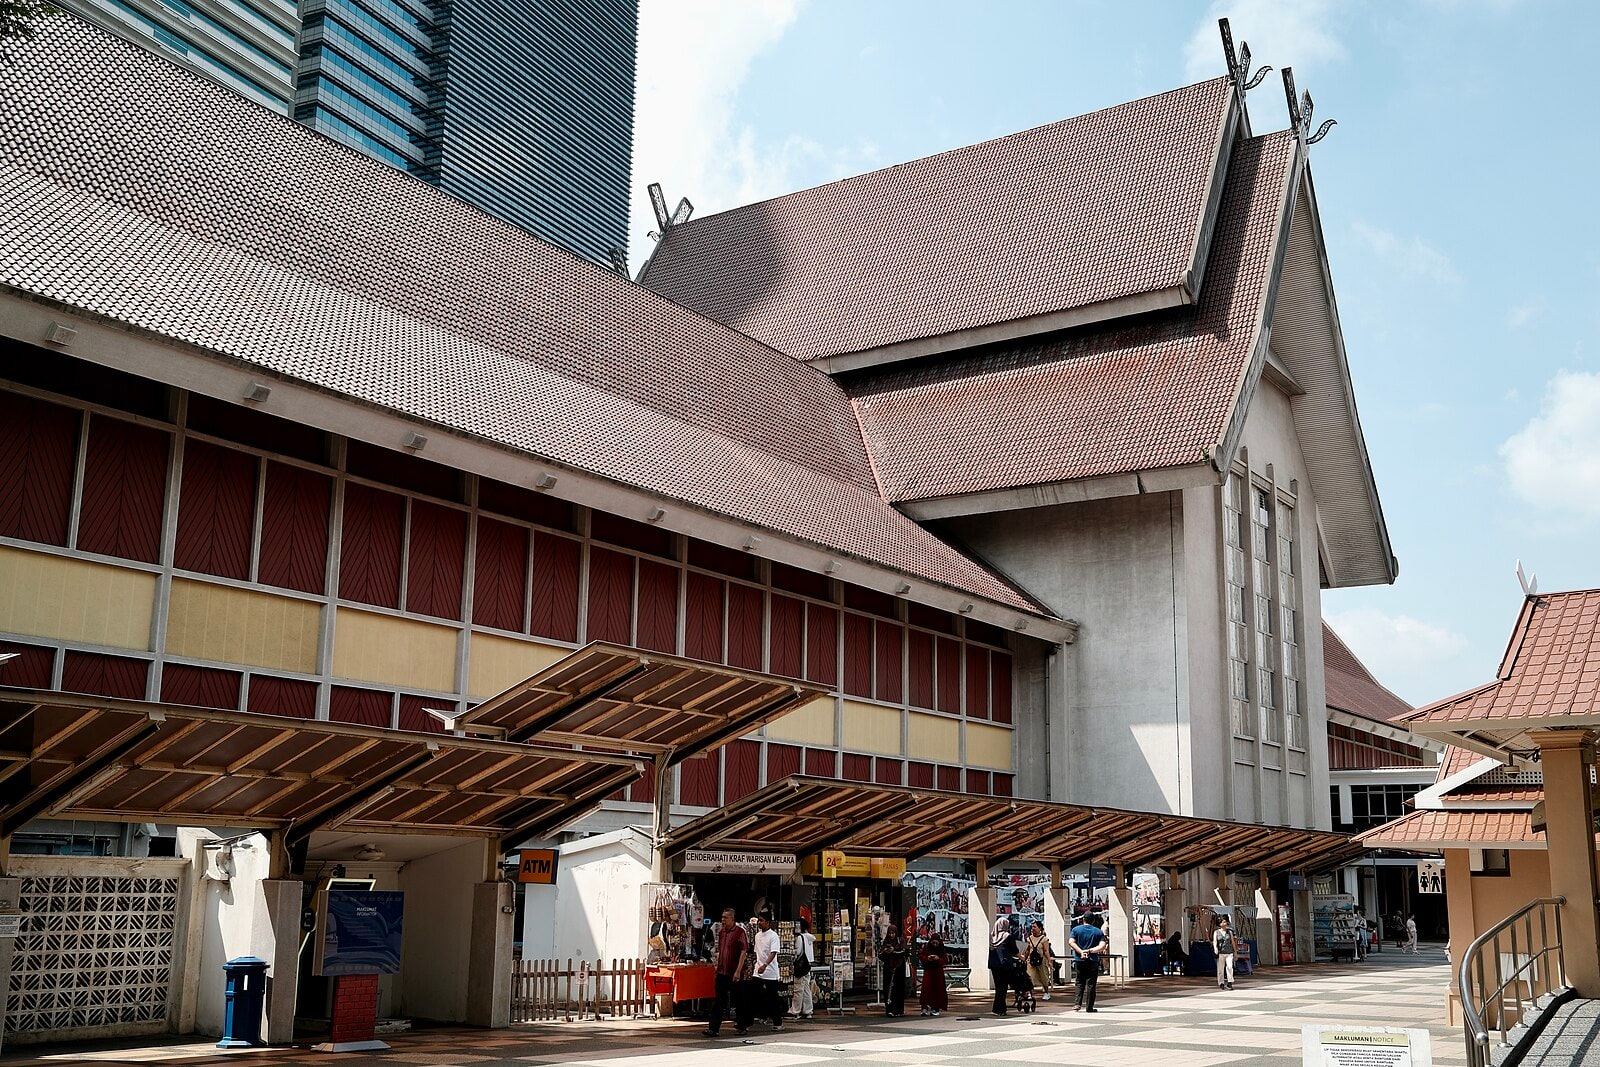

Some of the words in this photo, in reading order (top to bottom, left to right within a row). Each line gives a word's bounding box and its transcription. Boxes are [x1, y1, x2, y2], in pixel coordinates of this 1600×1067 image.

[686, 853, 729, 862] CENDERAHATI
[729, 854, 745, 863] KRAF
[746, 855, 771, 863] WARISAN
[772, 855, 794, 864] MELAKA
[826, 857, 836, 867] 24
[522, 860, 551, 873] ATM
